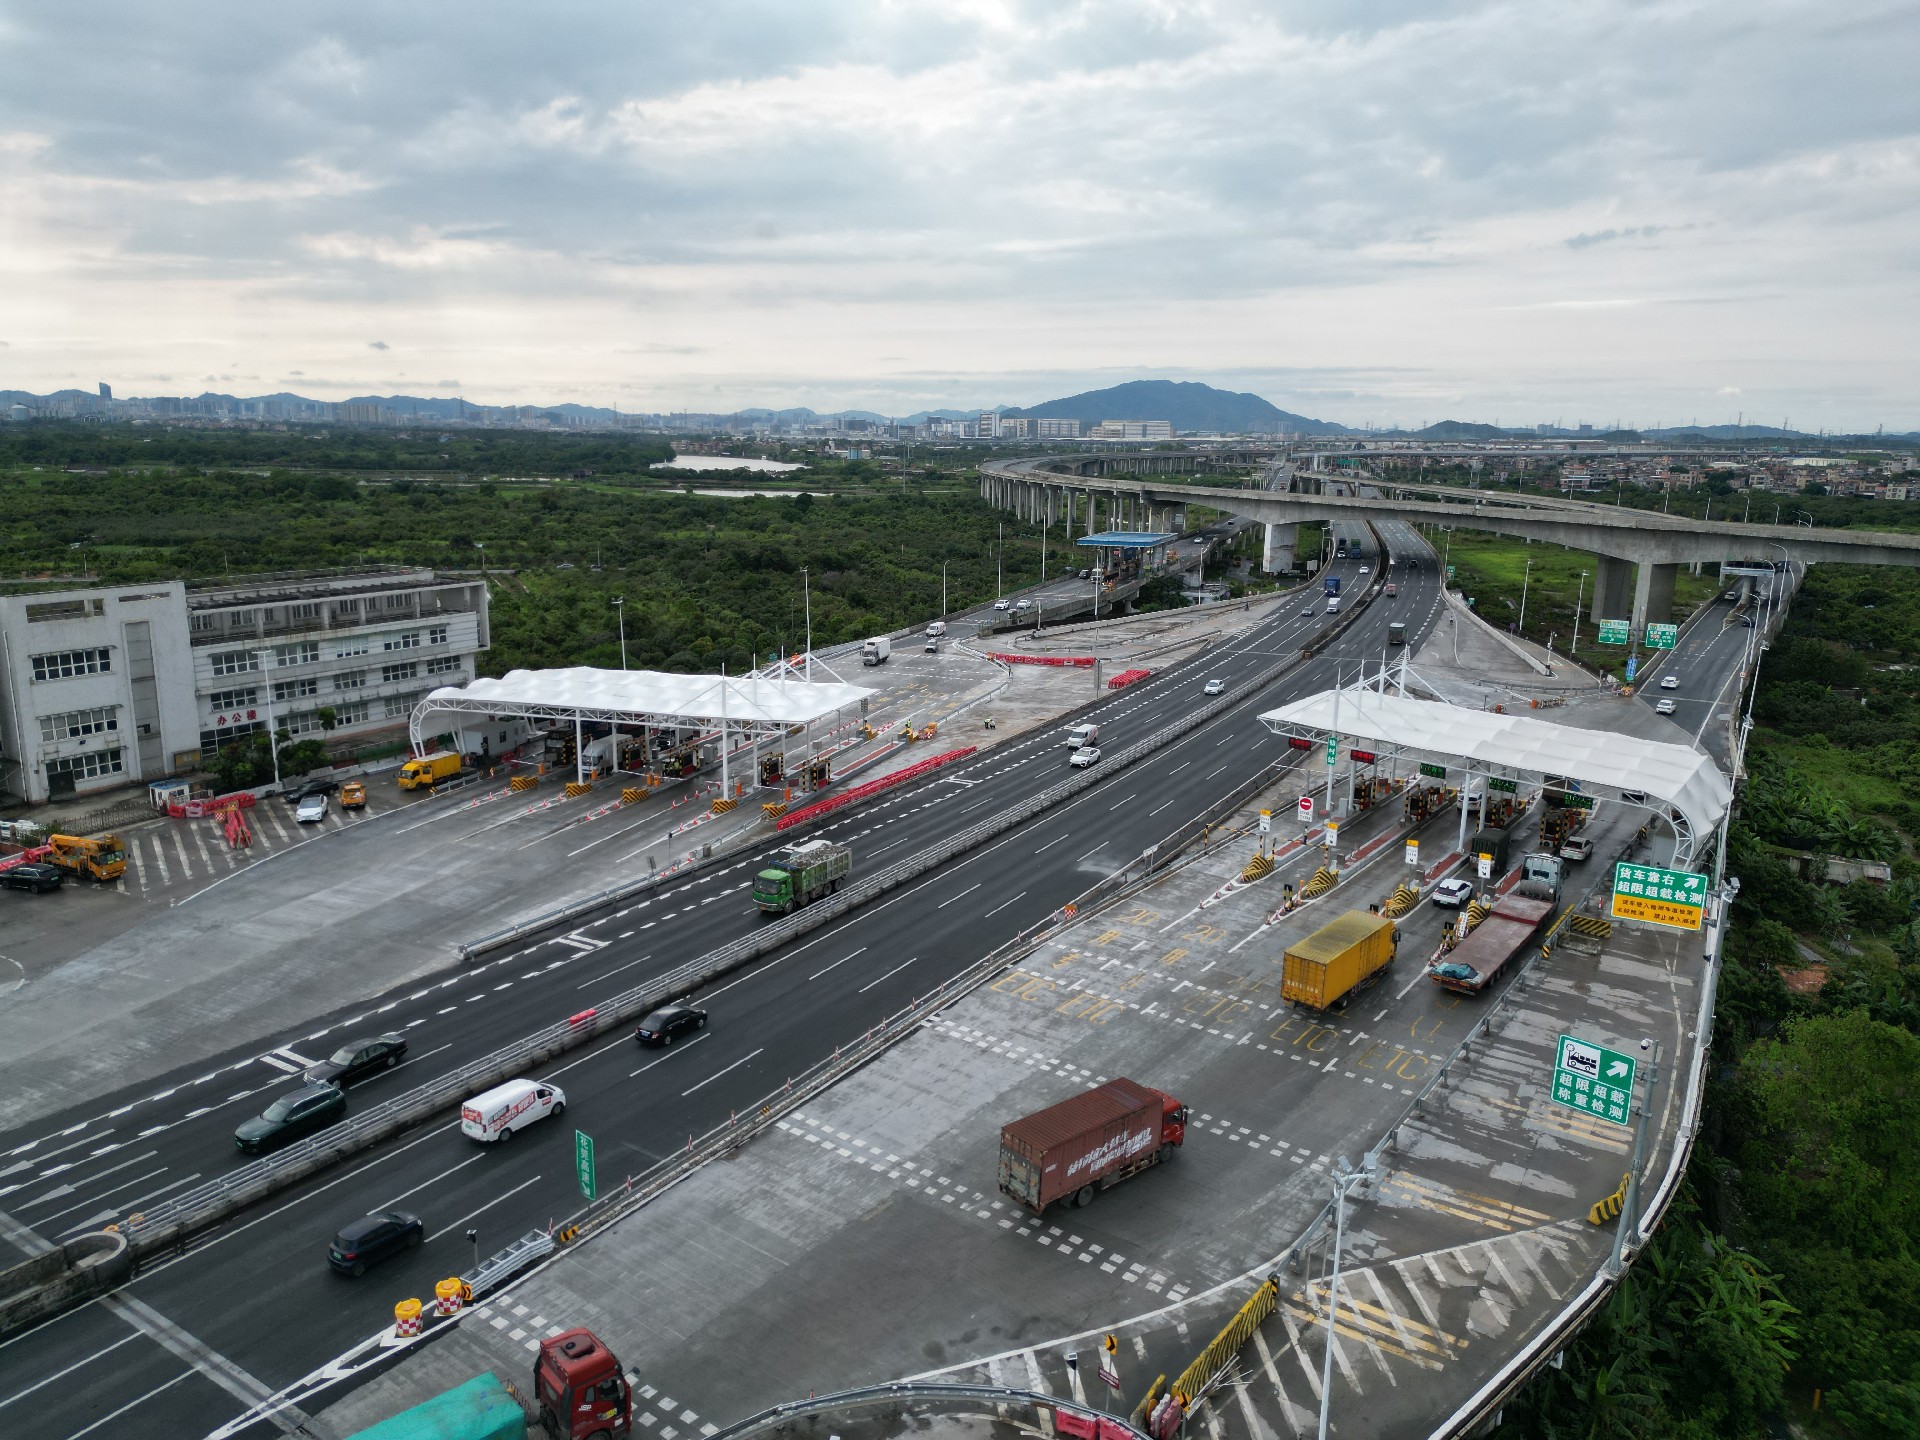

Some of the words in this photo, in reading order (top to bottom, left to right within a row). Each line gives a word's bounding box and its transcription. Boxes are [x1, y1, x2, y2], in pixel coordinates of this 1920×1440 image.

[217, 709, 257, 726] 办公楼
[1617, 880, 1703, 905] 超限超载检测
[1620, 867, 1675, 886] 货车靠右
[1183, 924, 1228, 944] 20
[990, 971, 1057, 1001] ETC
[1056, 992, 1127, 1025] ETC
[1181, 991, 1250, 1024] ETC
[1270, 1018, 1339, 1052] ETC
[1357, 1042, 1430, 1081] ETC
[1557, 1086, 1624, 1120] 称重检测
[1559, 1072, 1626, 1106] 超限超载
